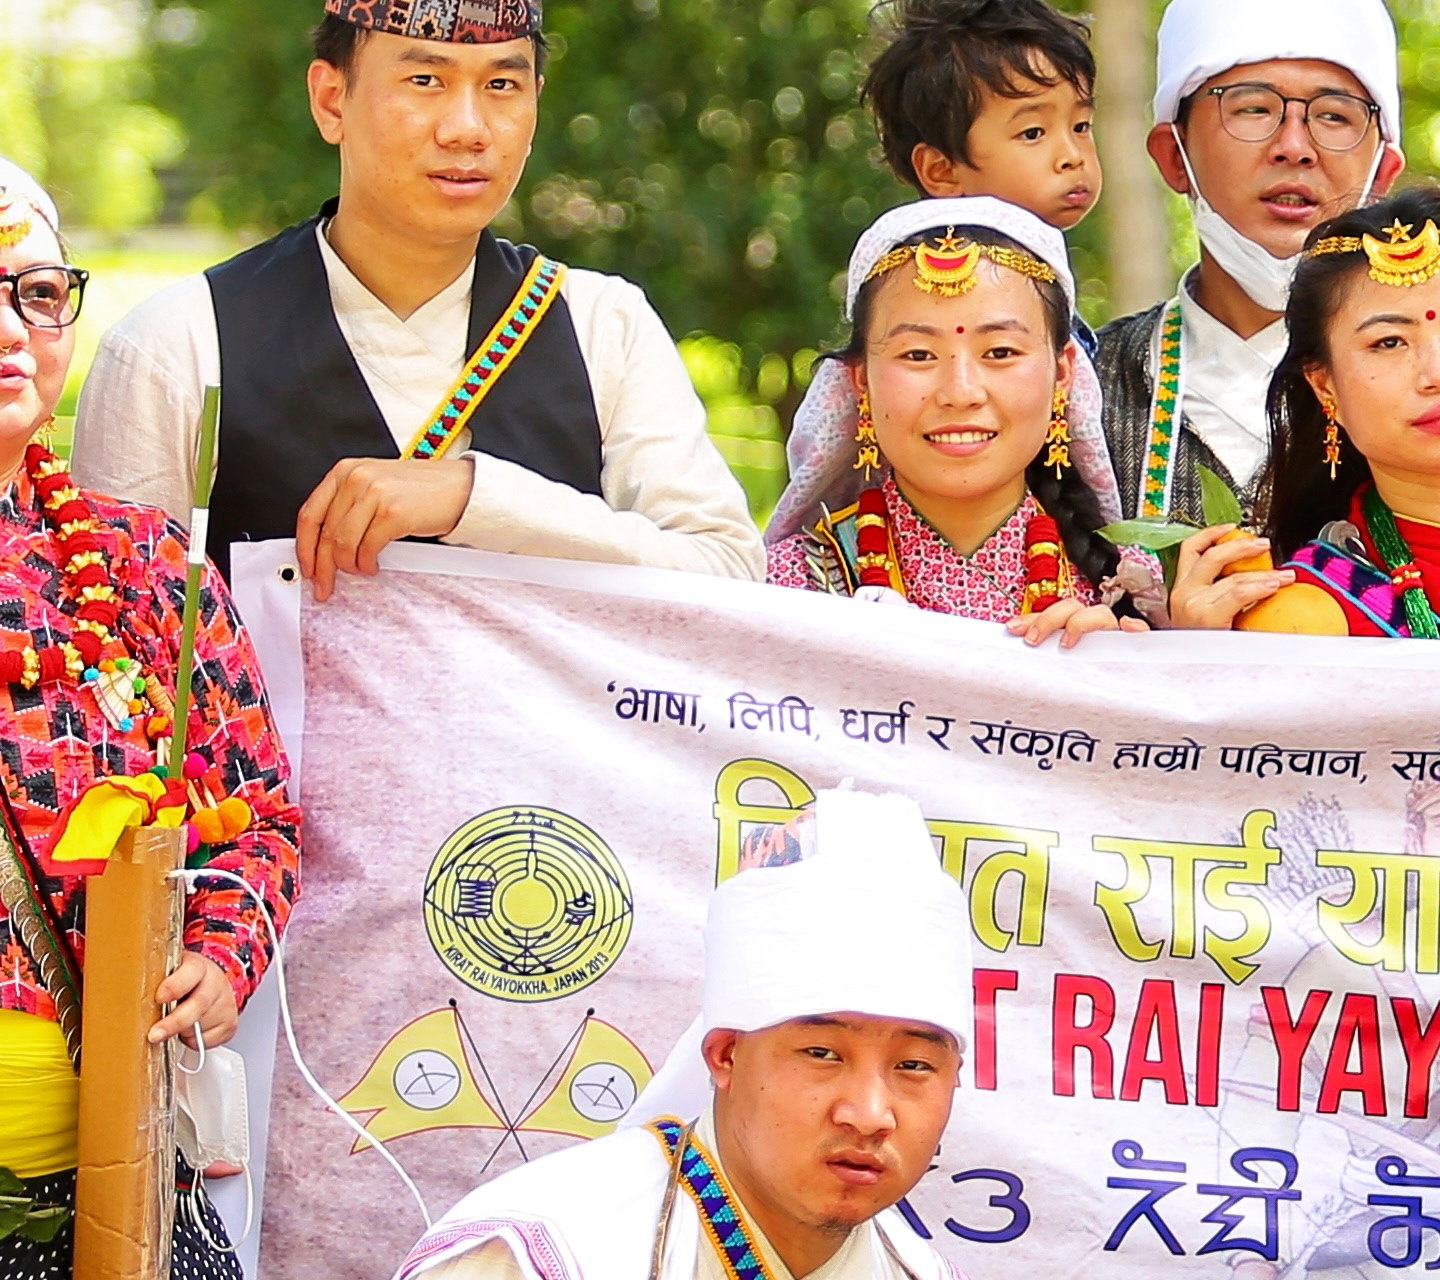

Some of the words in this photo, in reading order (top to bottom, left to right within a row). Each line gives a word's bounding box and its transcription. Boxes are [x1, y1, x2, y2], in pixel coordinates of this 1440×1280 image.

[839, 701, 916, 745] धर्म
[926, 715, 957, 751] र
[1113, 737, 1206, 773] हाम्रो
[1093, 810, 1281, 985] राई
[446, 946, 472, 973] KIRAT
[472, 969, 488, 985] RAI
[553, 971, 587, 992] JAPAN
[587, 952, 609, 974] 2013
[1052, 973, 1225, 1107] RAI
